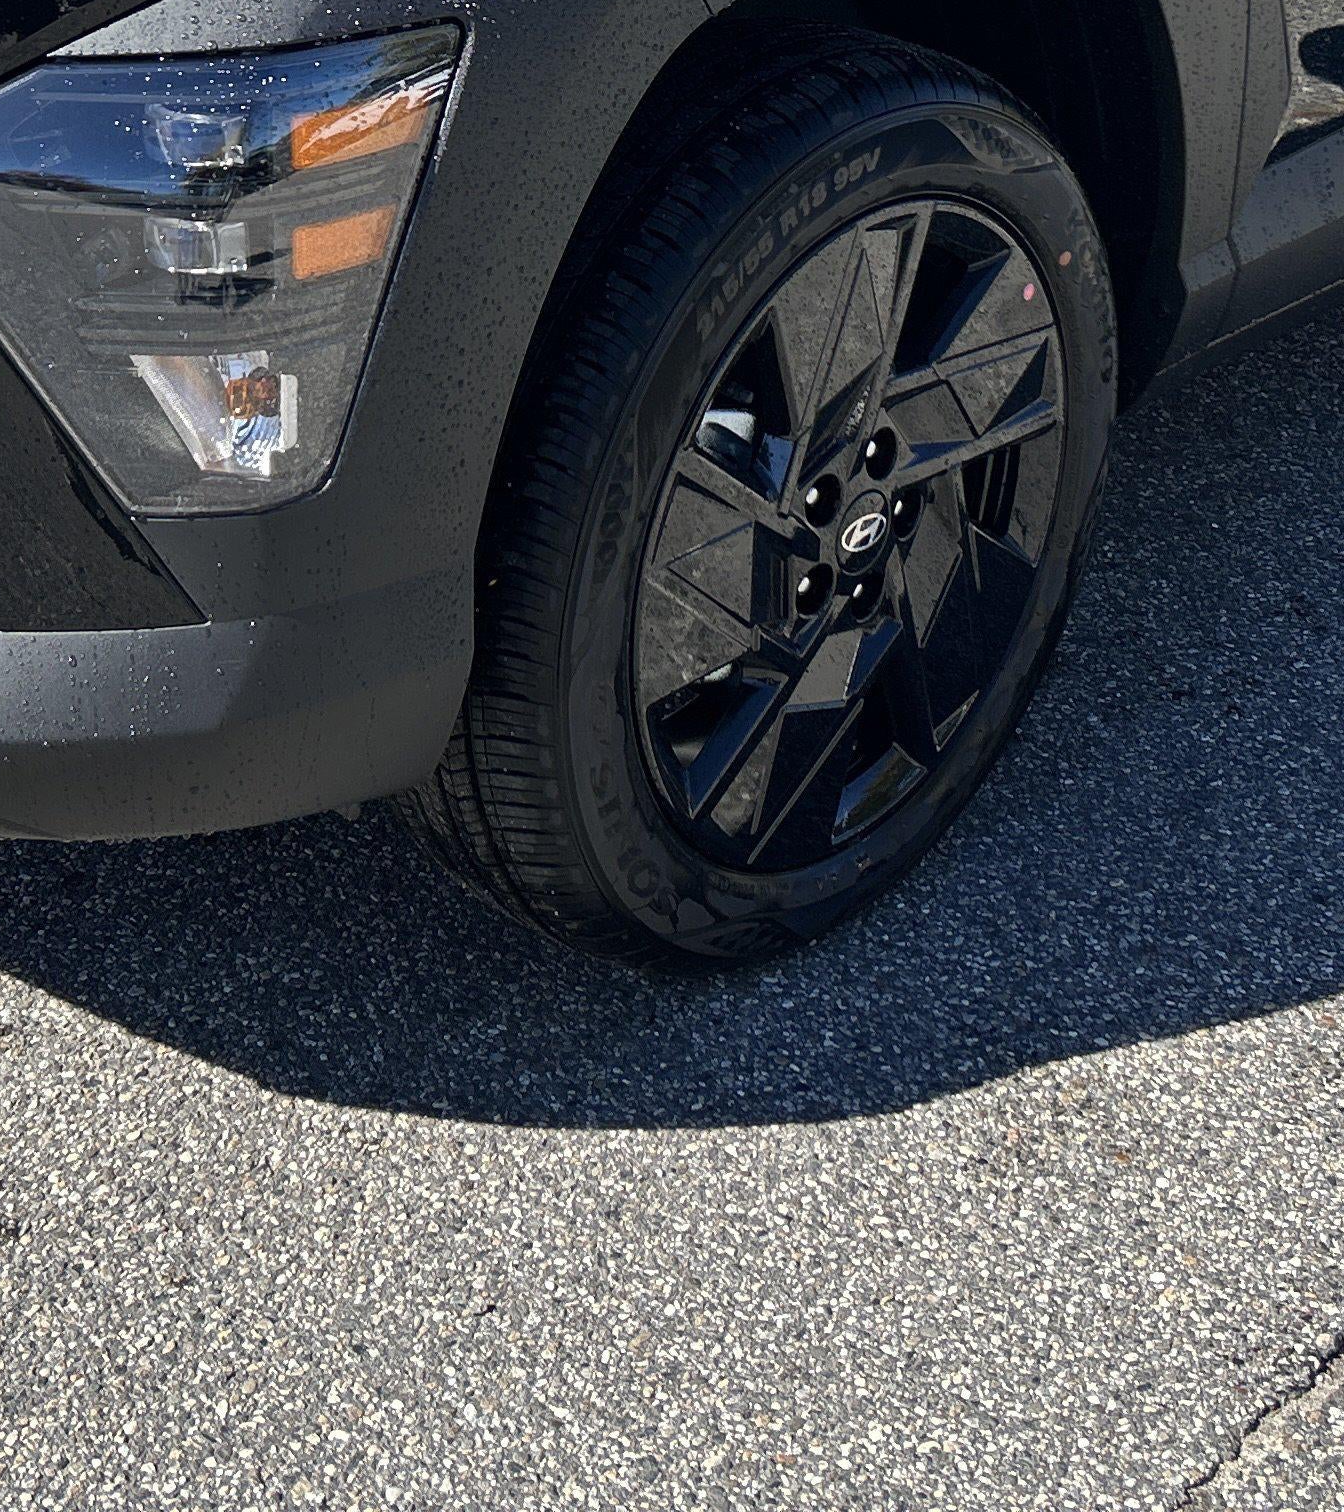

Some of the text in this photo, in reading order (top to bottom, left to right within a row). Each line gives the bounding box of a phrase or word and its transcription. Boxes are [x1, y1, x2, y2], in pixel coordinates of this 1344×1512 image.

[696, 146, 882, 343] 215/55 R18 95V
